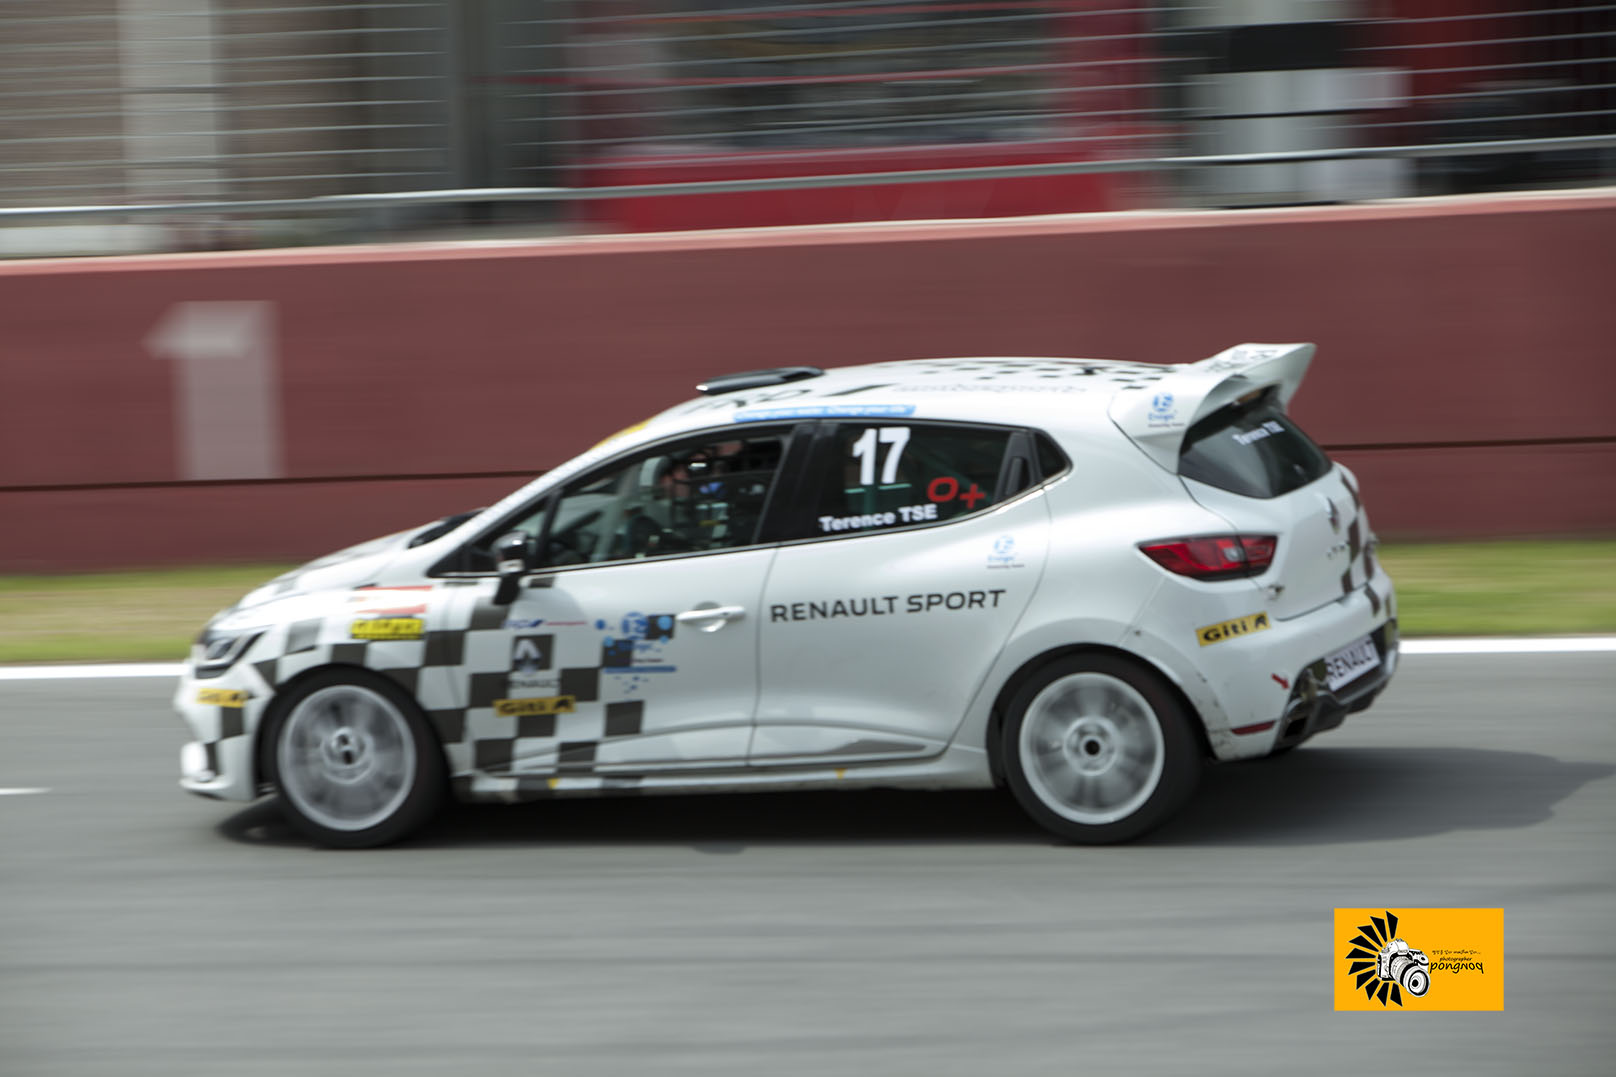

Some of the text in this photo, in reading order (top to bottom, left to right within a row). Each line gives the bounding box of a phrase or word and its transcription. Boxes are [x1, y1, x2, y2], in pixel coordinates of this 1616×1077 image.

[145, 301, 283, 479] 1
[852, 426, 911, 486] 17
[819, 503, 938, 532] Terence TSE
[770, 589, 1006, 623] RENAULT SPORT
[1202, 620, 1248, 643] Giti
